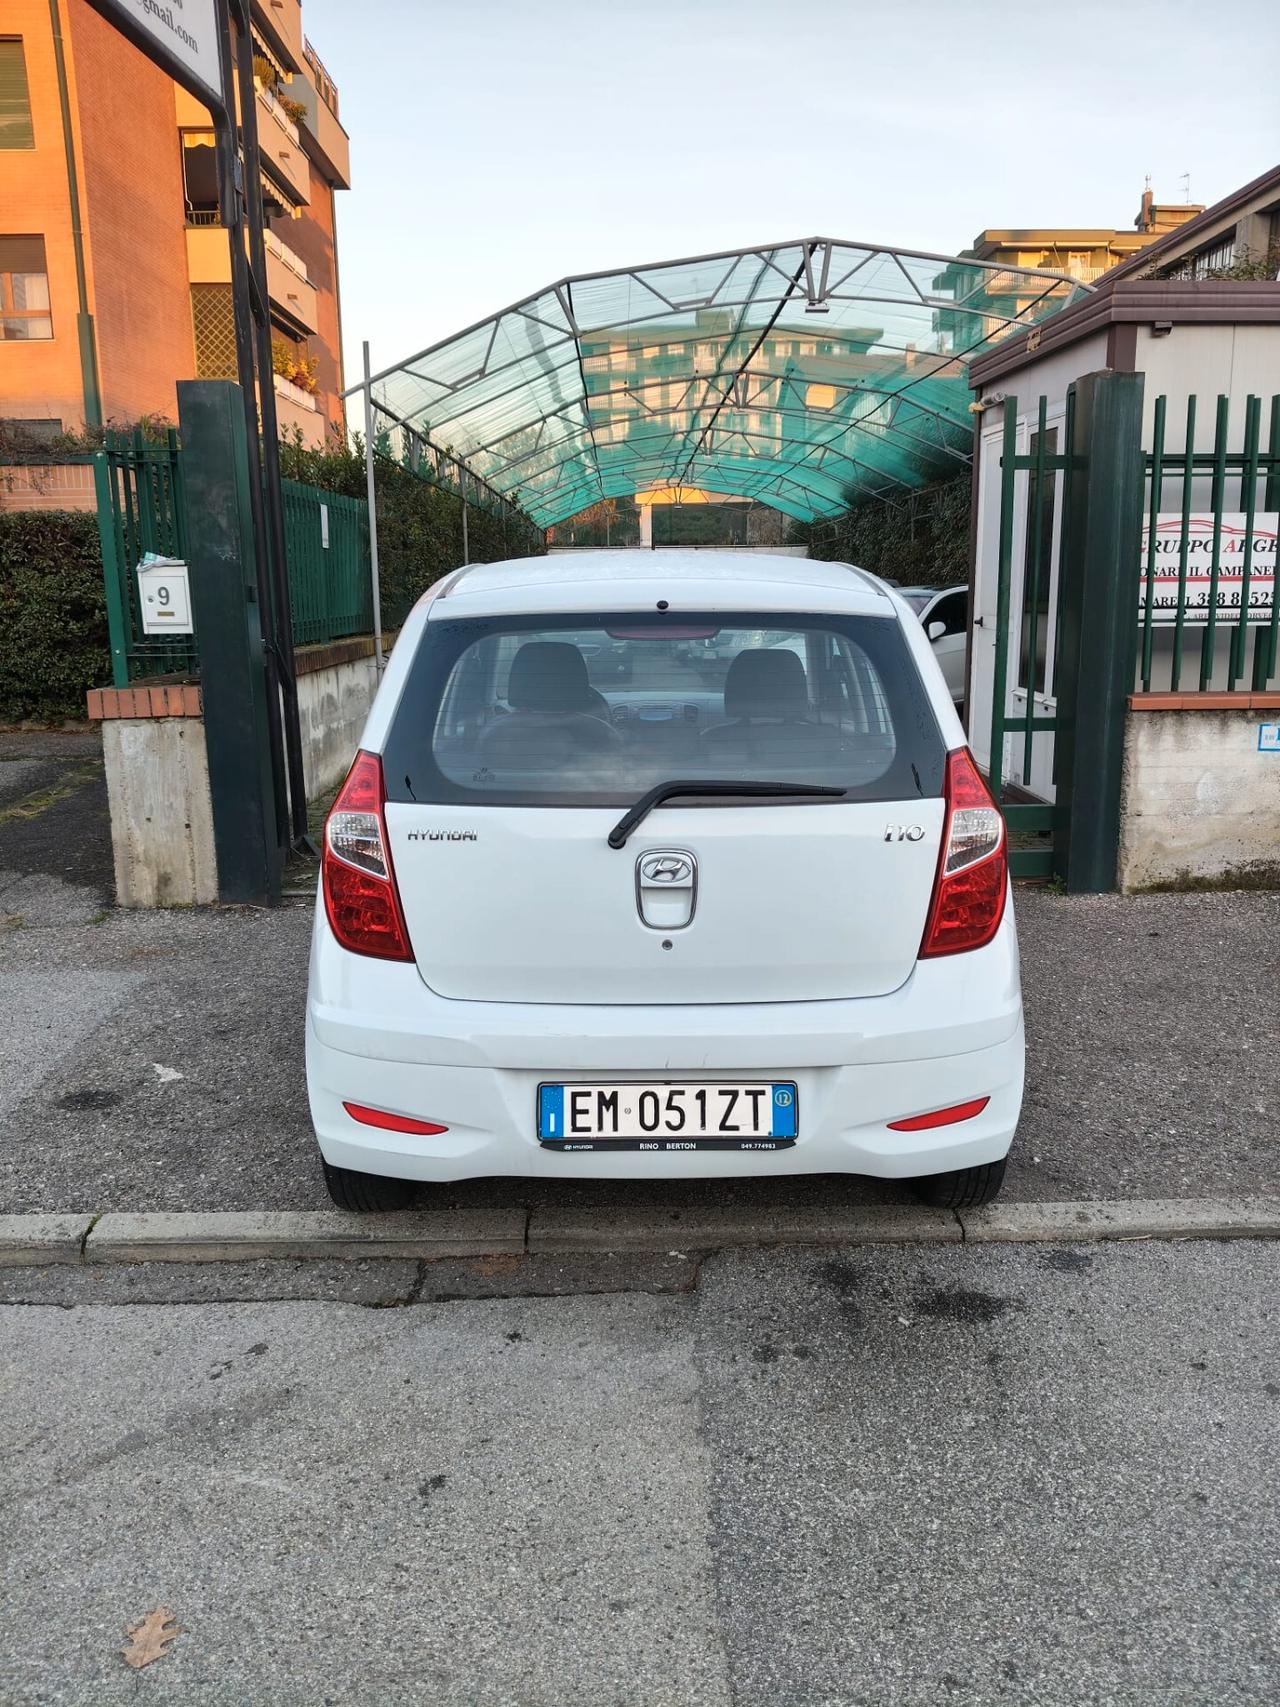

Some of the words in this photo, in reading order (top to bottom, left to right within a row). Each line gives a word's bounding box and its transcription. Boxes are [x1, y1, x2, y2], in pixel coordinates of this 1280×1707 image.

[137, 0, 198, 53] gmail.com
[1189, 566, 1203, 577] IL
[158, 586, 170, 606] 9
[407, 828, 478, 841] HYUNDAI
[884, 823, 925, 842] i10
[778, 1094, 790, 1105] 12
[570, 1090, 619, 1133] EM
[638, 1089, 766, 1133] 051ZT
[639, 1142, 659, 1150] RINO
[666, 1142, 697, 1150] BERTON
